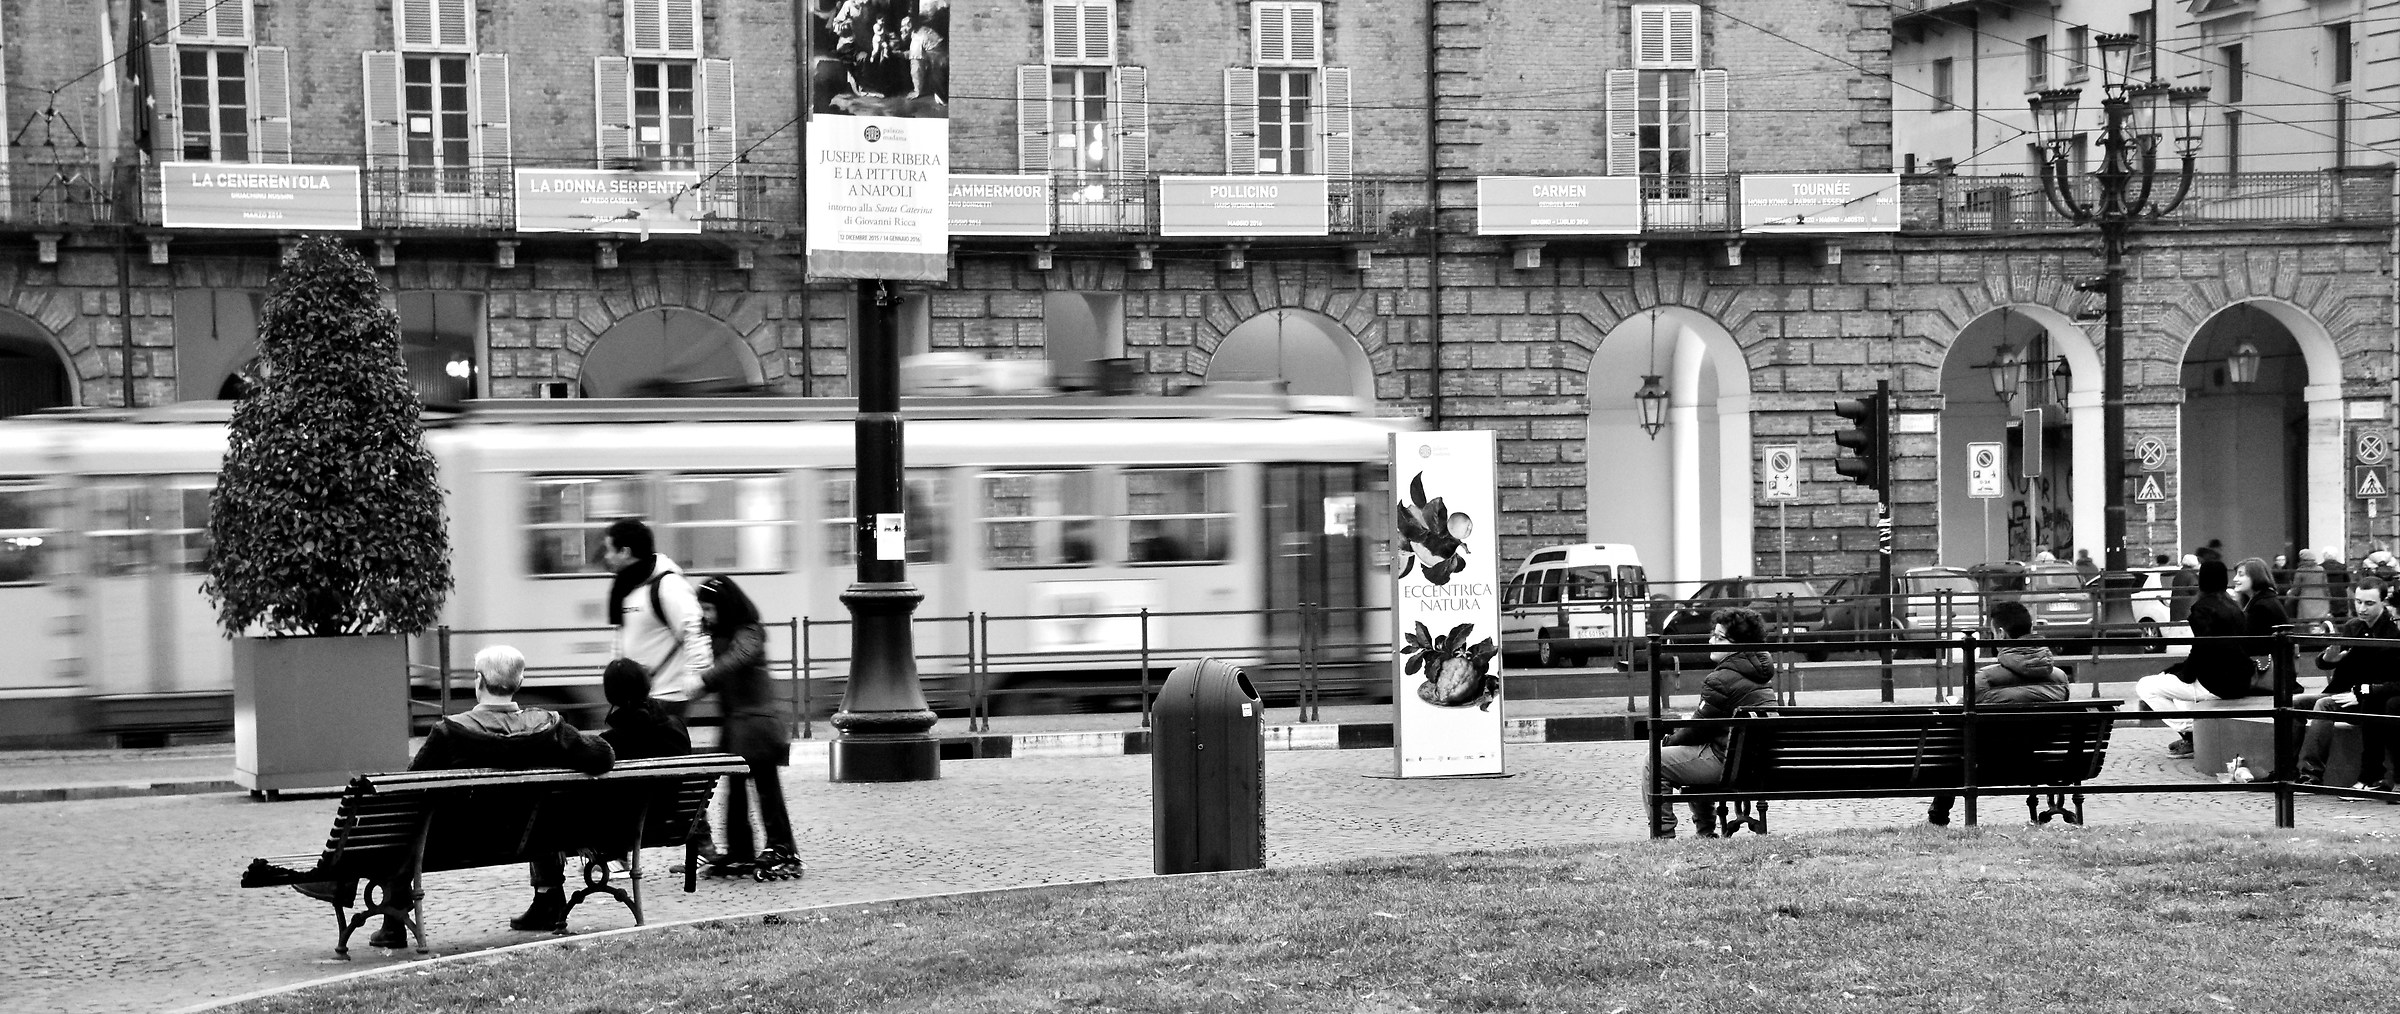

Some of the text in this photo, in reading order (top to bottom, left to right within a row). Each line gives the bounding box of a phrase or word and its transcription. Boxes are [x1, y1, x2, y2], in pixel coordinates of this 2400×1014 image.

[820, 150, 941, 166] JUSEPE DE RIBERA
[192, 173, 331, 190] LA CENERENTOLA
[834, 167, 927, 182] E LA PITTURA
[530, 179, 686, 194] LA DONNA SERPENTE
[848, 184, 912, 198] A NAPOLI
[1210, 185, 1278, 198] POLLICINO
[1532, 184, 1586, 198] CARMEN
[1792, 180, 1850, 196] TOURNÉE
[828, 202, 932, 214] intorno alla Santa Caterina
[1748, 198, 1768, 206] HONG
[1768, 198, 1788, 206] KONG
[1822, 198, 1845, 206] ESSEN
[844, 216, 916, 226] di Giovanni Ricca
[1404, 584, 1492, 598] ECCENTRICA
[1421, 598, 1480, 612] NATURA
